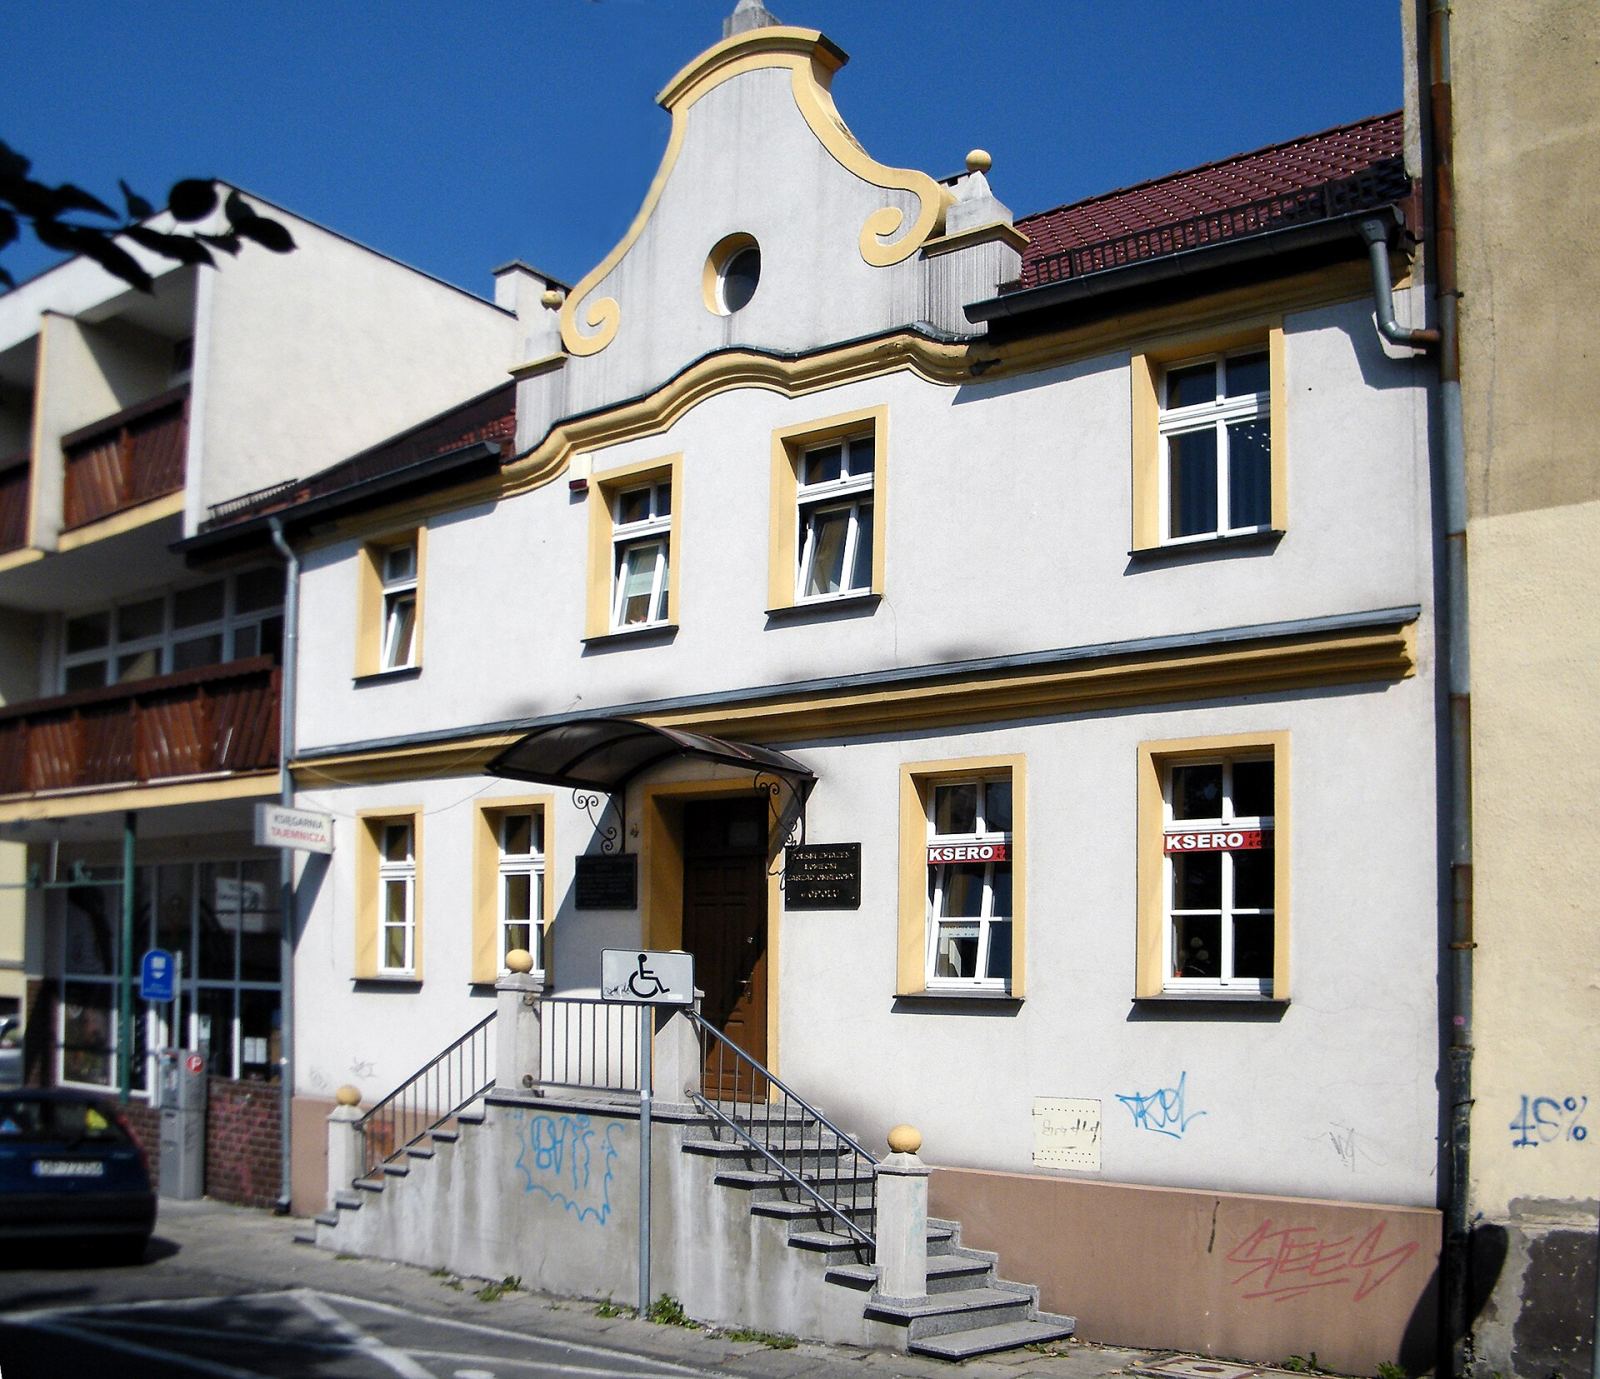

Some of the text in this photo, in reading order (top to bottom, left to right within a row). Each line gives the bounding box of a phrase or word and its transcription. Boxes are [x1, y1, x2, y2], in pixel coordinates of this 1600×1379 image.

[271, 826, 327, 844] TAJEMNICZA
[1166, 832, 1244, 850] KSERO
[928, 845, 994, 861] KSERO
